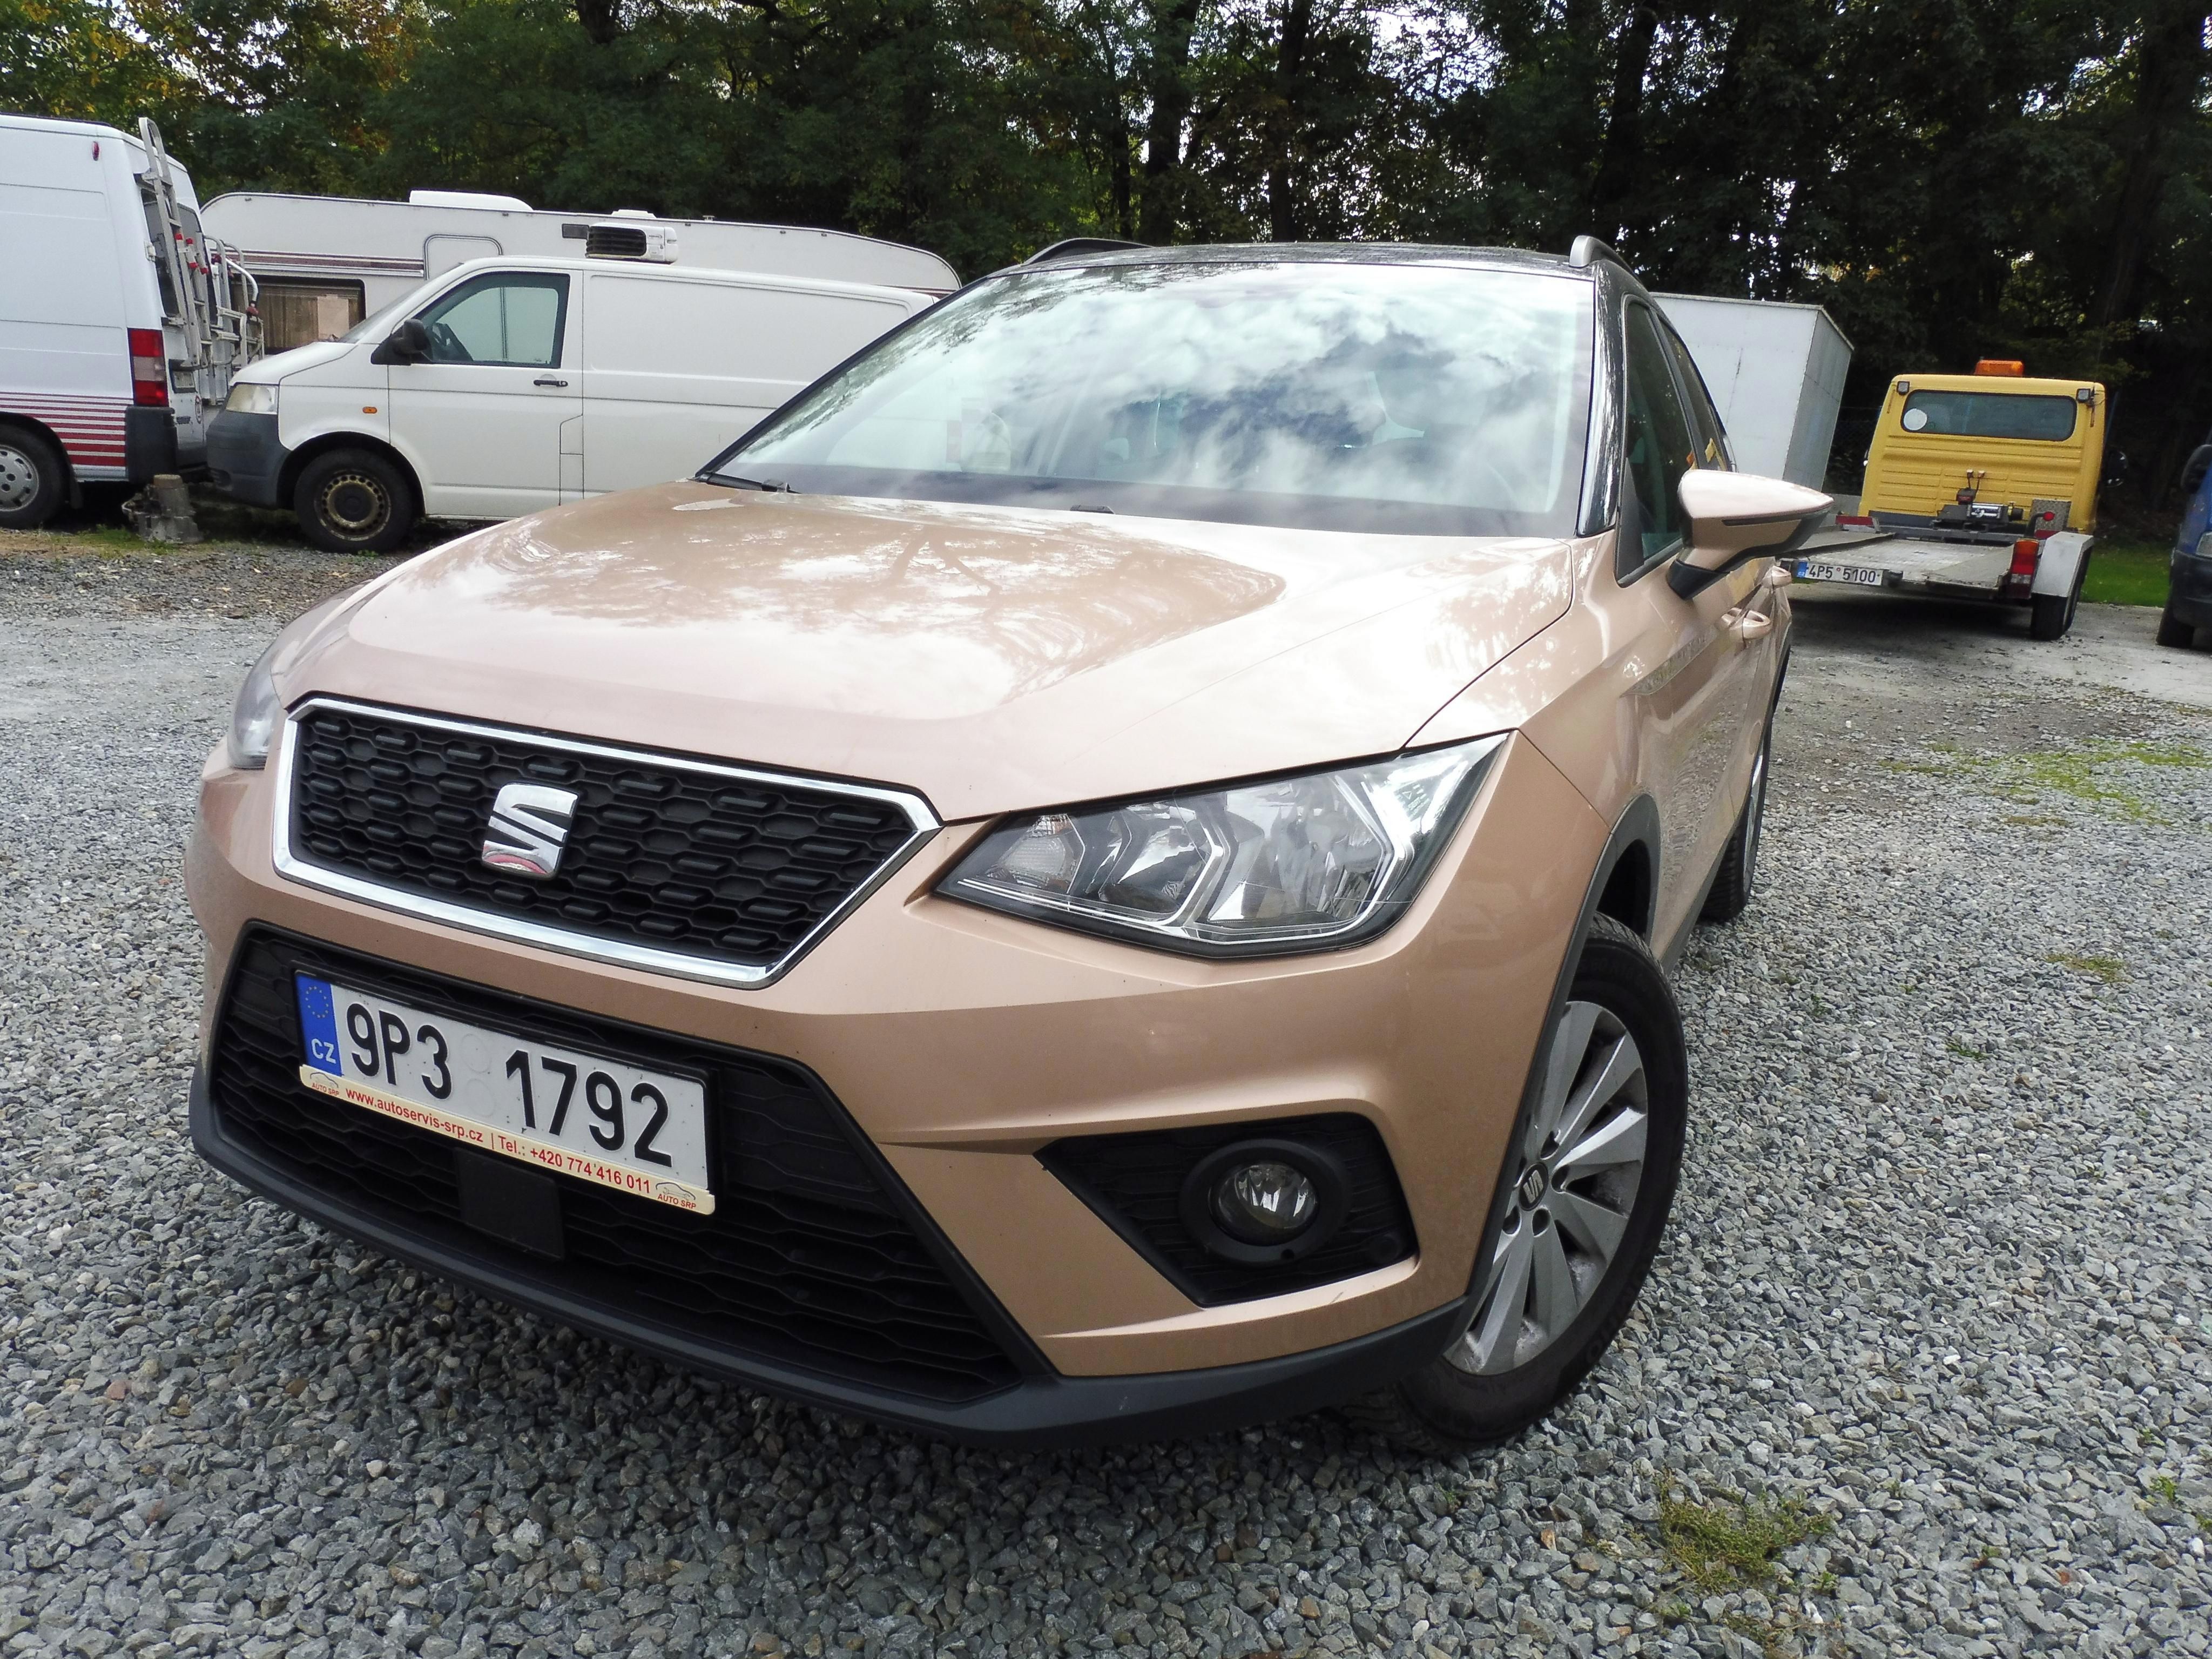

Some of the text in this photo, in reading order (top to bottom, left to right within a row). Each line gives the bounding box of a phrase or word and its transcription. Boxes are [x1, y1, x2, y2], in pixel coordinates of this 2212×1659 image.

[1809, 565, 1876, 583] 4P5 5100
[311, 1038, 336, 1064] CZ
[312, 1082, 340, 1096] AUTO SRP
[347, 1003, 672, 1168] 9P3 1792
[346, 1088, 484, 1143] www.autoservis-srp.cz
[498, 1135, 525, 1156] Tel.:
[530, 1148, 562, 1167] +420
[567, 1156, 592, 1176] 774
[596, 1166, 622, 1185] 416
[626, 1175, 650, 1193] 011
[657, 1193, 697, 1210] AUTO SRP
